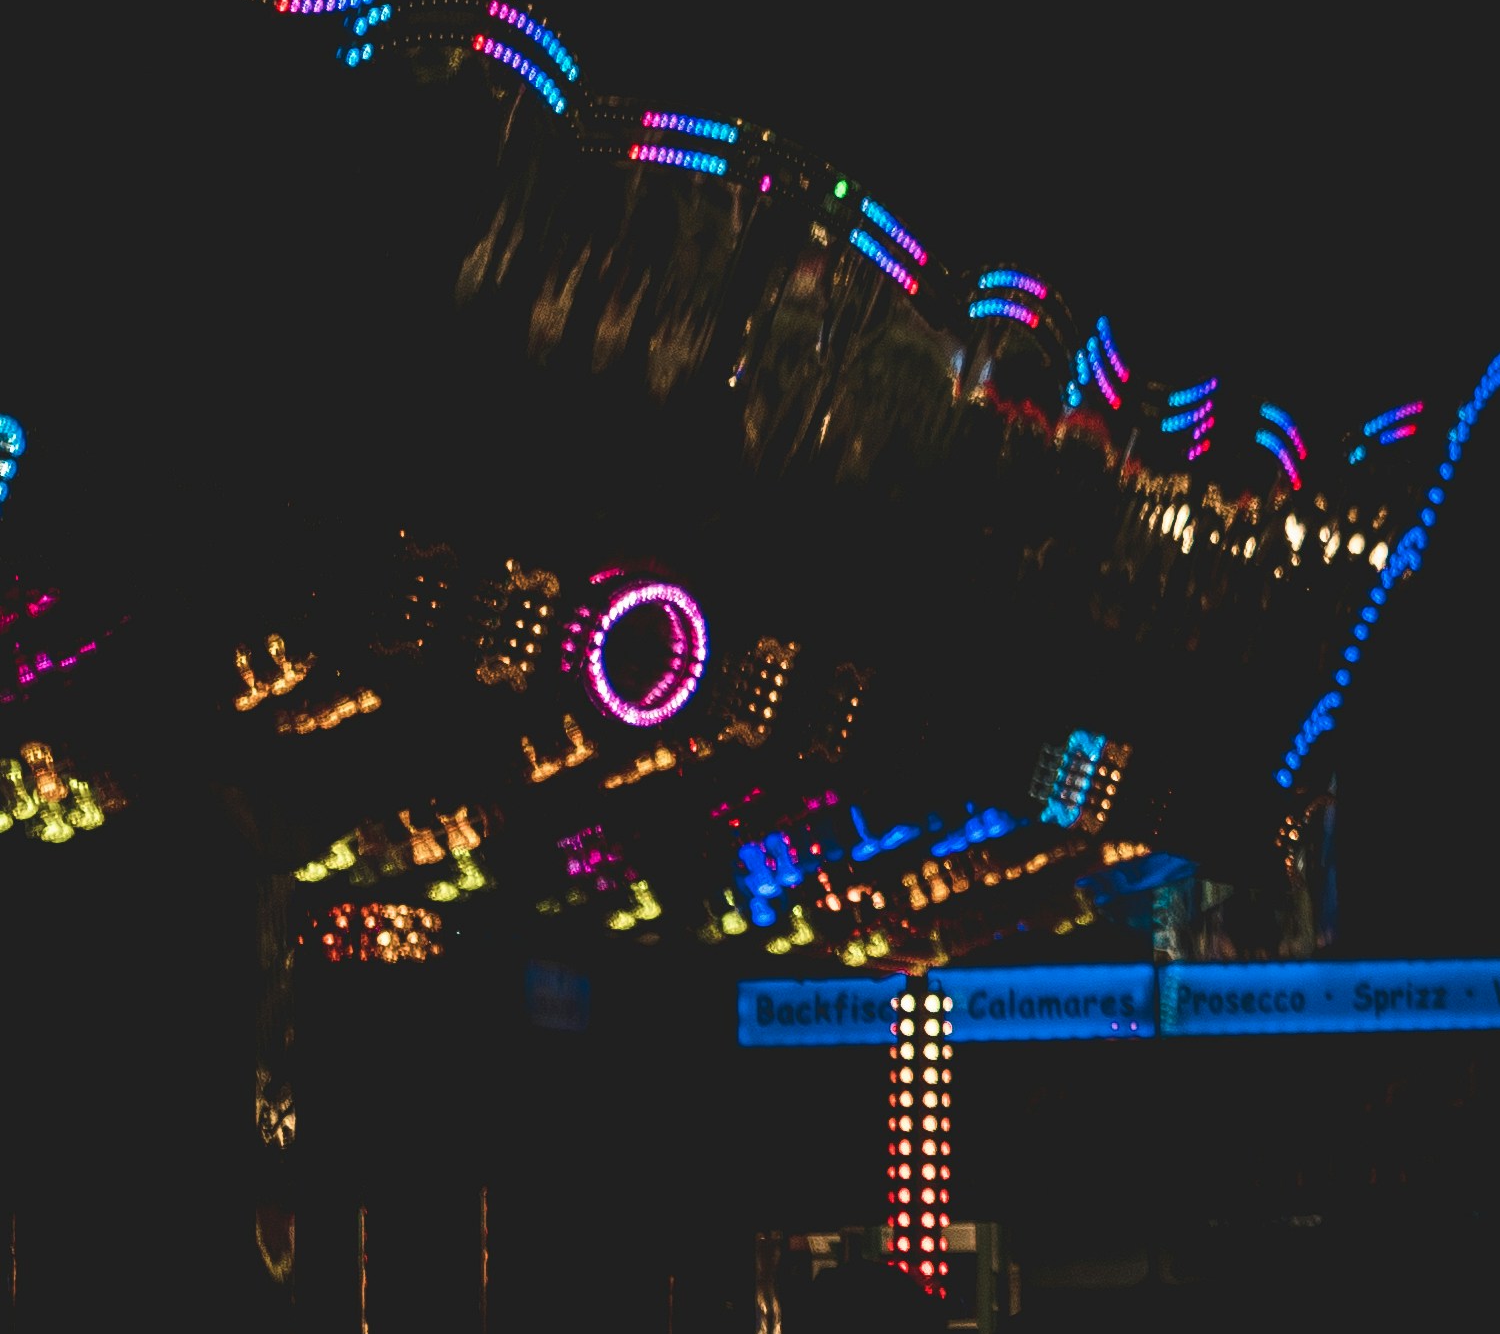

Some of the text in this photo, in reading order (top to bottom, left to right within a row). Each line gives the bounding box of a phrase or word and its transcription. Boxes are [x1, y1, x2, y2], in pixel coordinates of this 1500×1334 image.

[966, 990, 1137, 1021] Calamares
[1177, 984, 1306, 1016] Prosecco
[1353, 981, 1448, 1021] Sprizz
